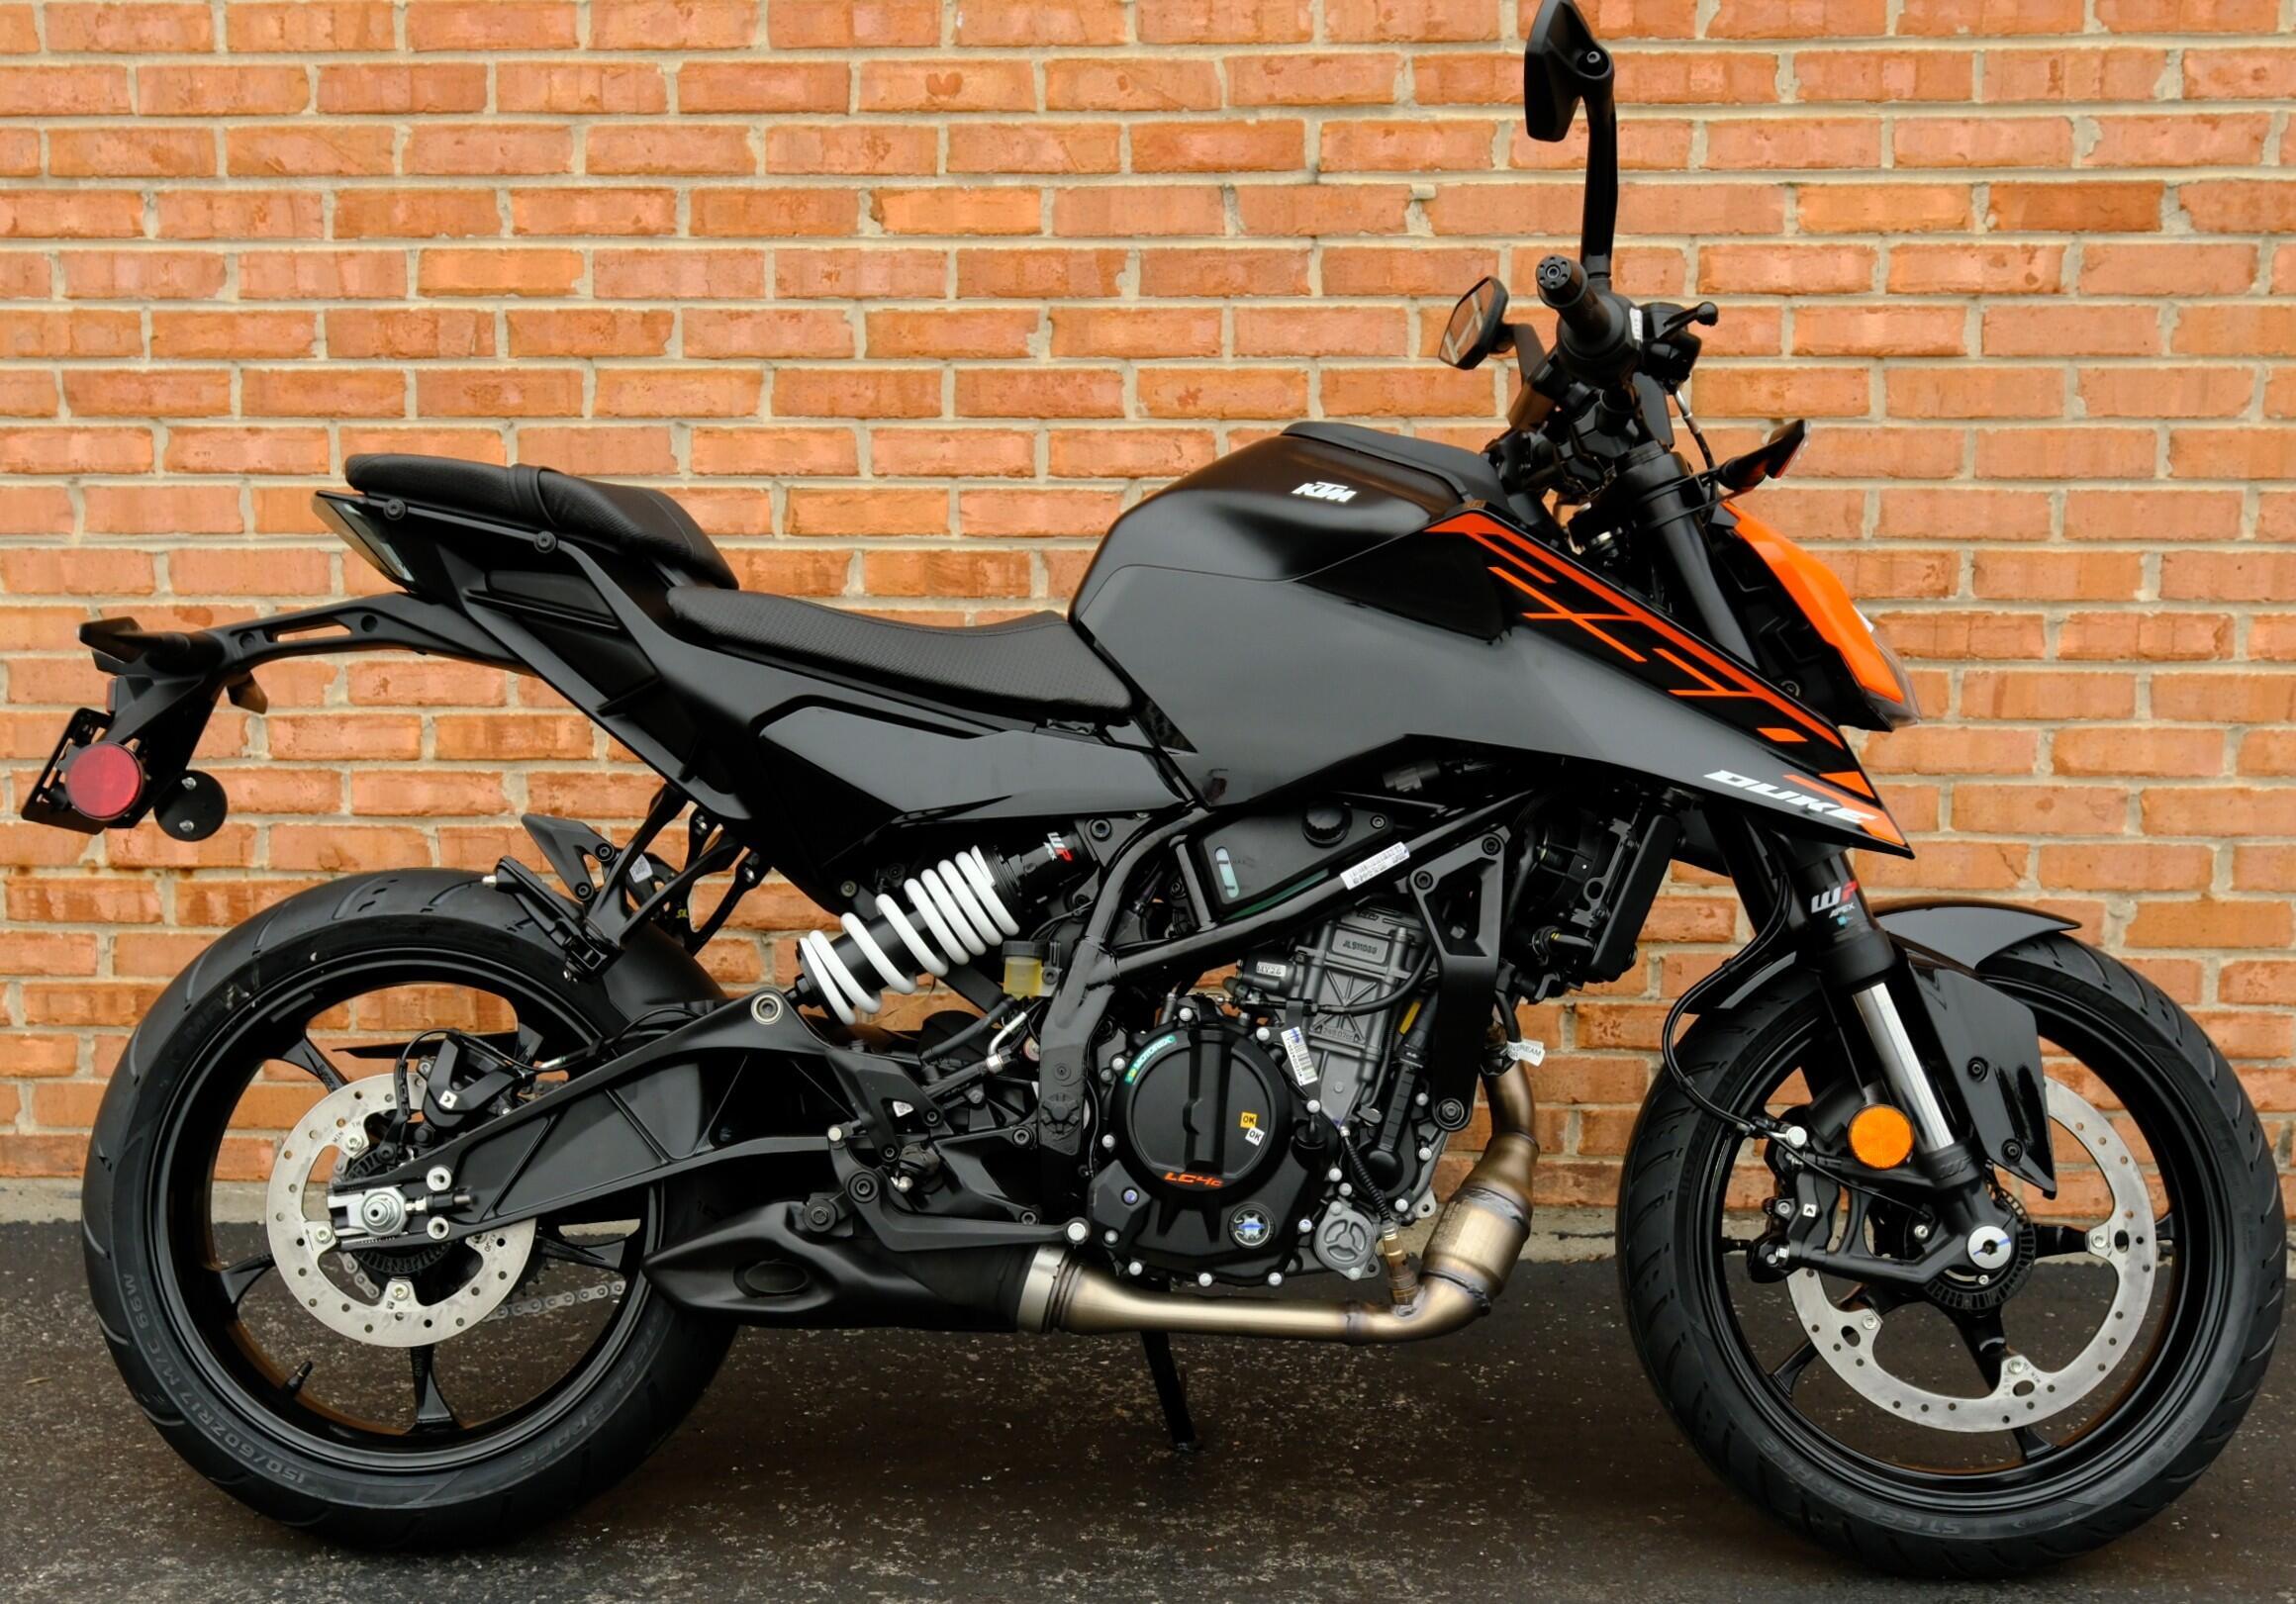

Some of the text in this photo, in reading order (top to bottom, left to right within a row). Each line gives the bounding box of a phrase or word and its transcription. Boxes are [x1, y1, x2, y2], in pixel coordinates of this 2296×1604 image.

[1291, 482, 1357, 503] KTM
[1703, 770, 1879, 824] DUKE
[1249, 1130, 1262, 1142] OK
[122, 1274, 150, 1329] 66W
